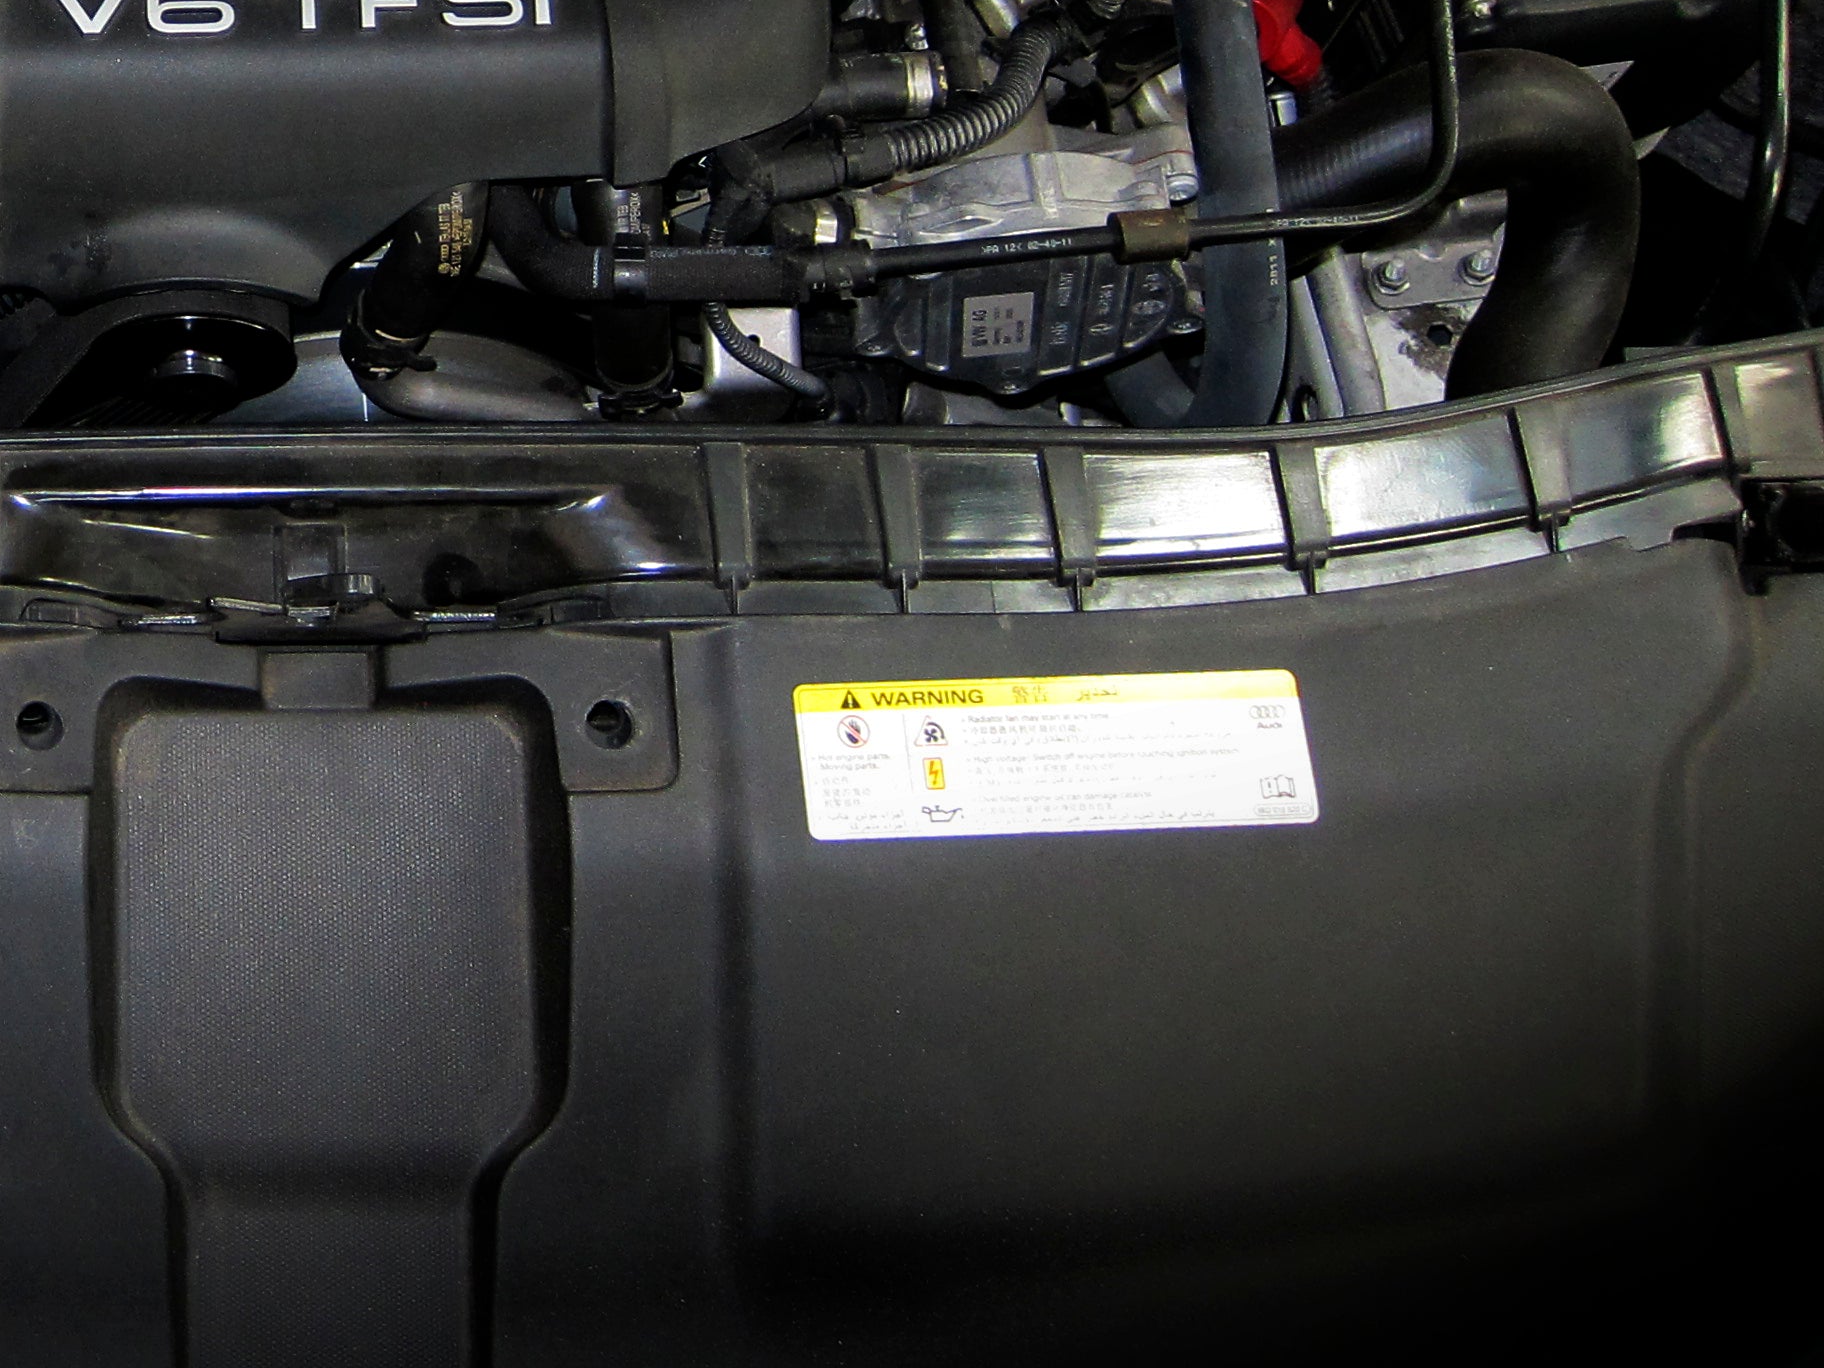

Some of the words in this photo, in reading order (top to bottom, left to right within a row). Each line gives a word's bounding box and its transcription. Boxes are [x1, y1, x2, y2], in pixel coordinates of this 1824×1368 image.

[871, 688, 985, 707] WARNING
[1021, 714, 1039, 723] may
[1257, 722, 1283, 730] Audi
